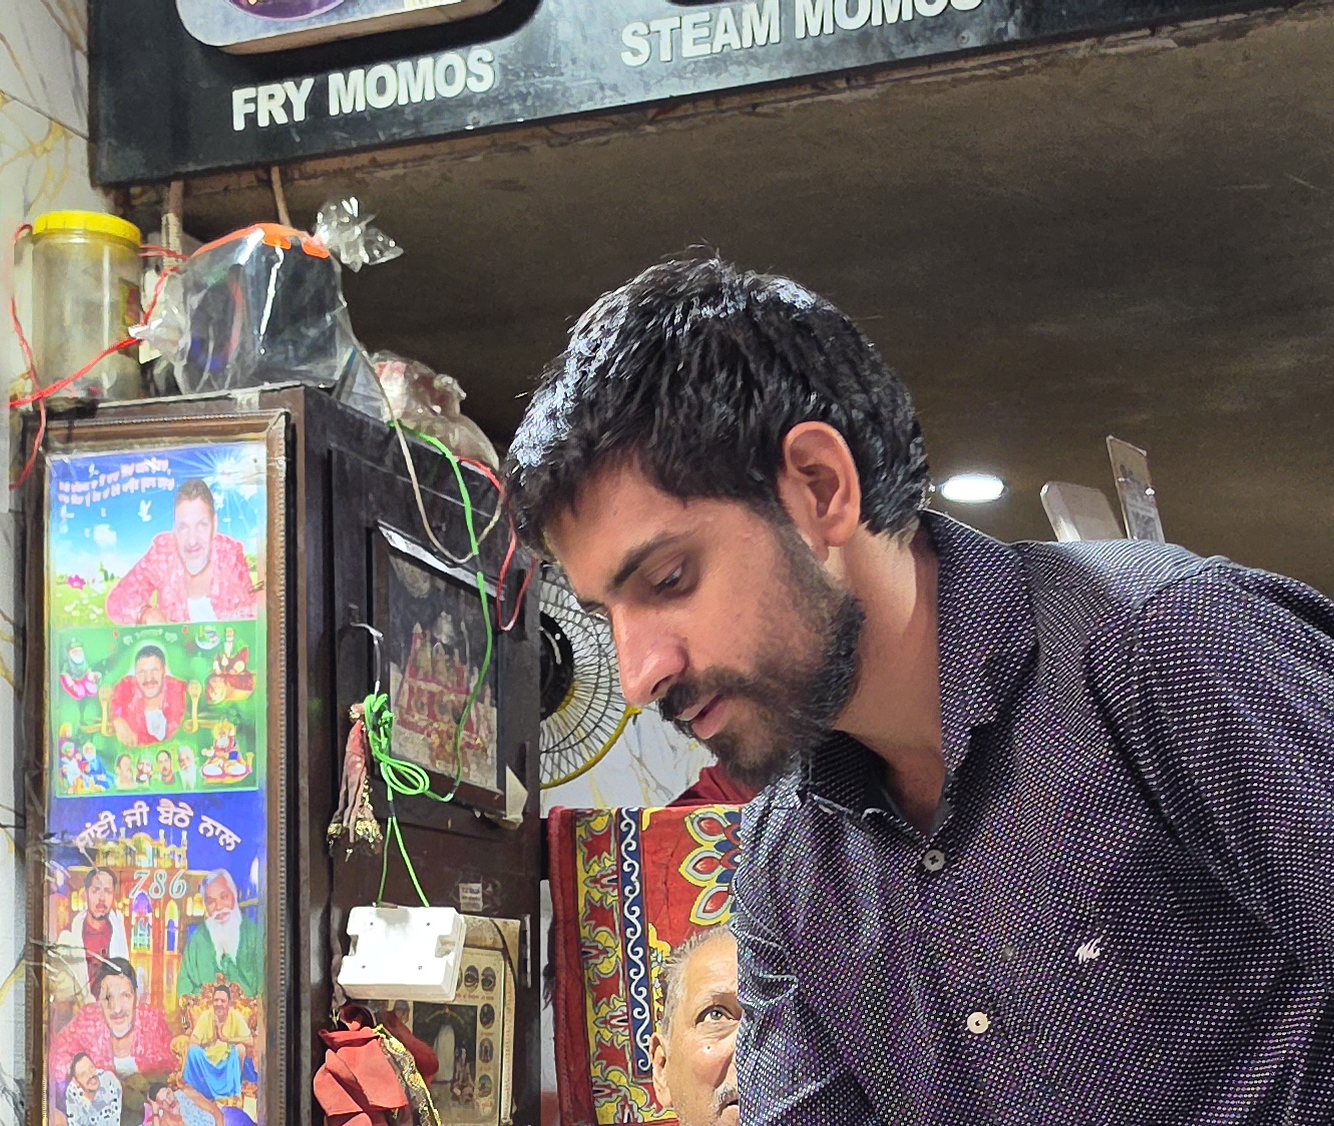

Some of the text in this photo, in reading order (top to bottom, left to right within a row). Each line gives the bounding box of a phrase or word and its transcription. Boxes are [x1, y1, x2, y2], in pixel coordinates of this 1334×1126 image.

[620, 0, 985, 67] STEAM MOM
[231, 48, 496, 132] FRY MOMOS
[122, 800, 151, 829] ਜੀ
[197, 814, 242, 853] ਨਾਲ
[128, 868, 188, 900] 786
